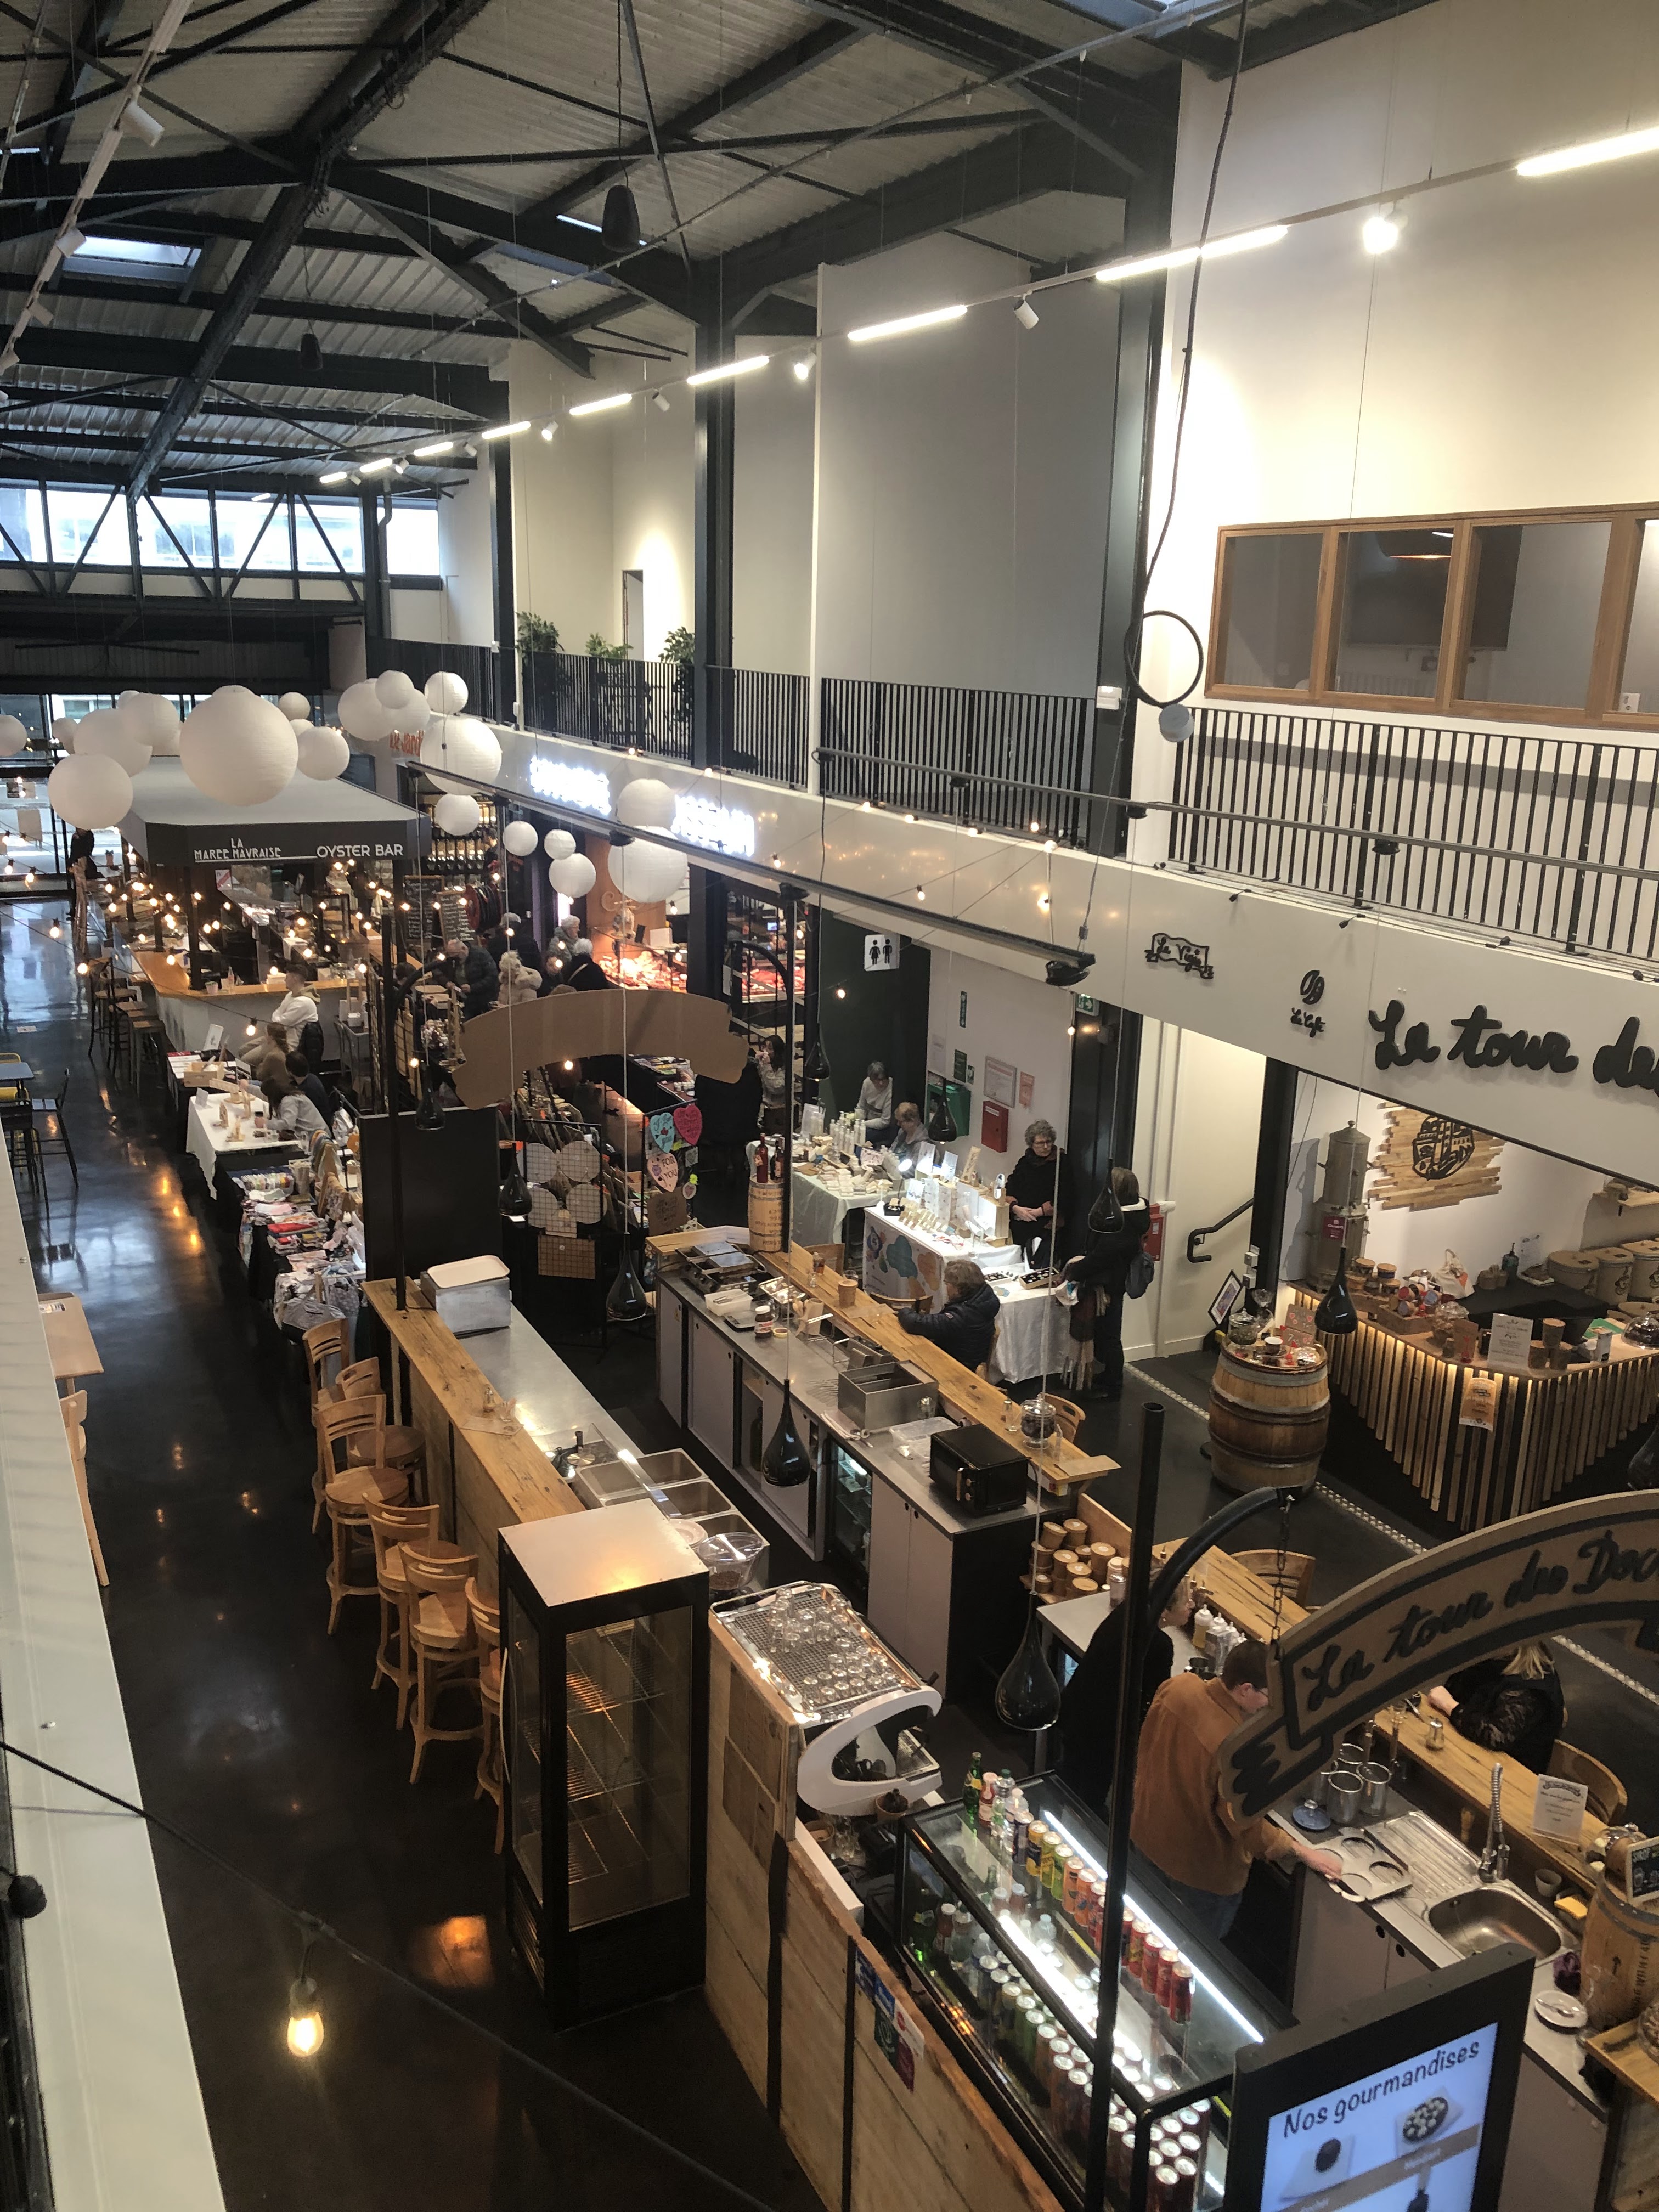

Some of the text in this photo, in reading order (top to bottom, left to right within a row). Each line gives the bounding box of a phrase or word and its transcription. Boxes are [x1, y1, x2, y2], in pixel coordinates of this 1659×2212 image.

[230, 838, 244, 848] LA
[233, 847, 281, 859] HAVRAISE
[317, 843, 404, 858] OYSTER BAR
[1447, 1005, 1579, 1073] tour
[1593, 1016, 1659, 1098] de
[662, 1156, 675, 1167] FOR
[663, 1168, 678, 1180] YOU
[1381, 1591, 1495, 1663] tour
[1572, 1529, 1659, 1594] Doc
[1283, 2041, 1480, 2138] Nos gourmandises
